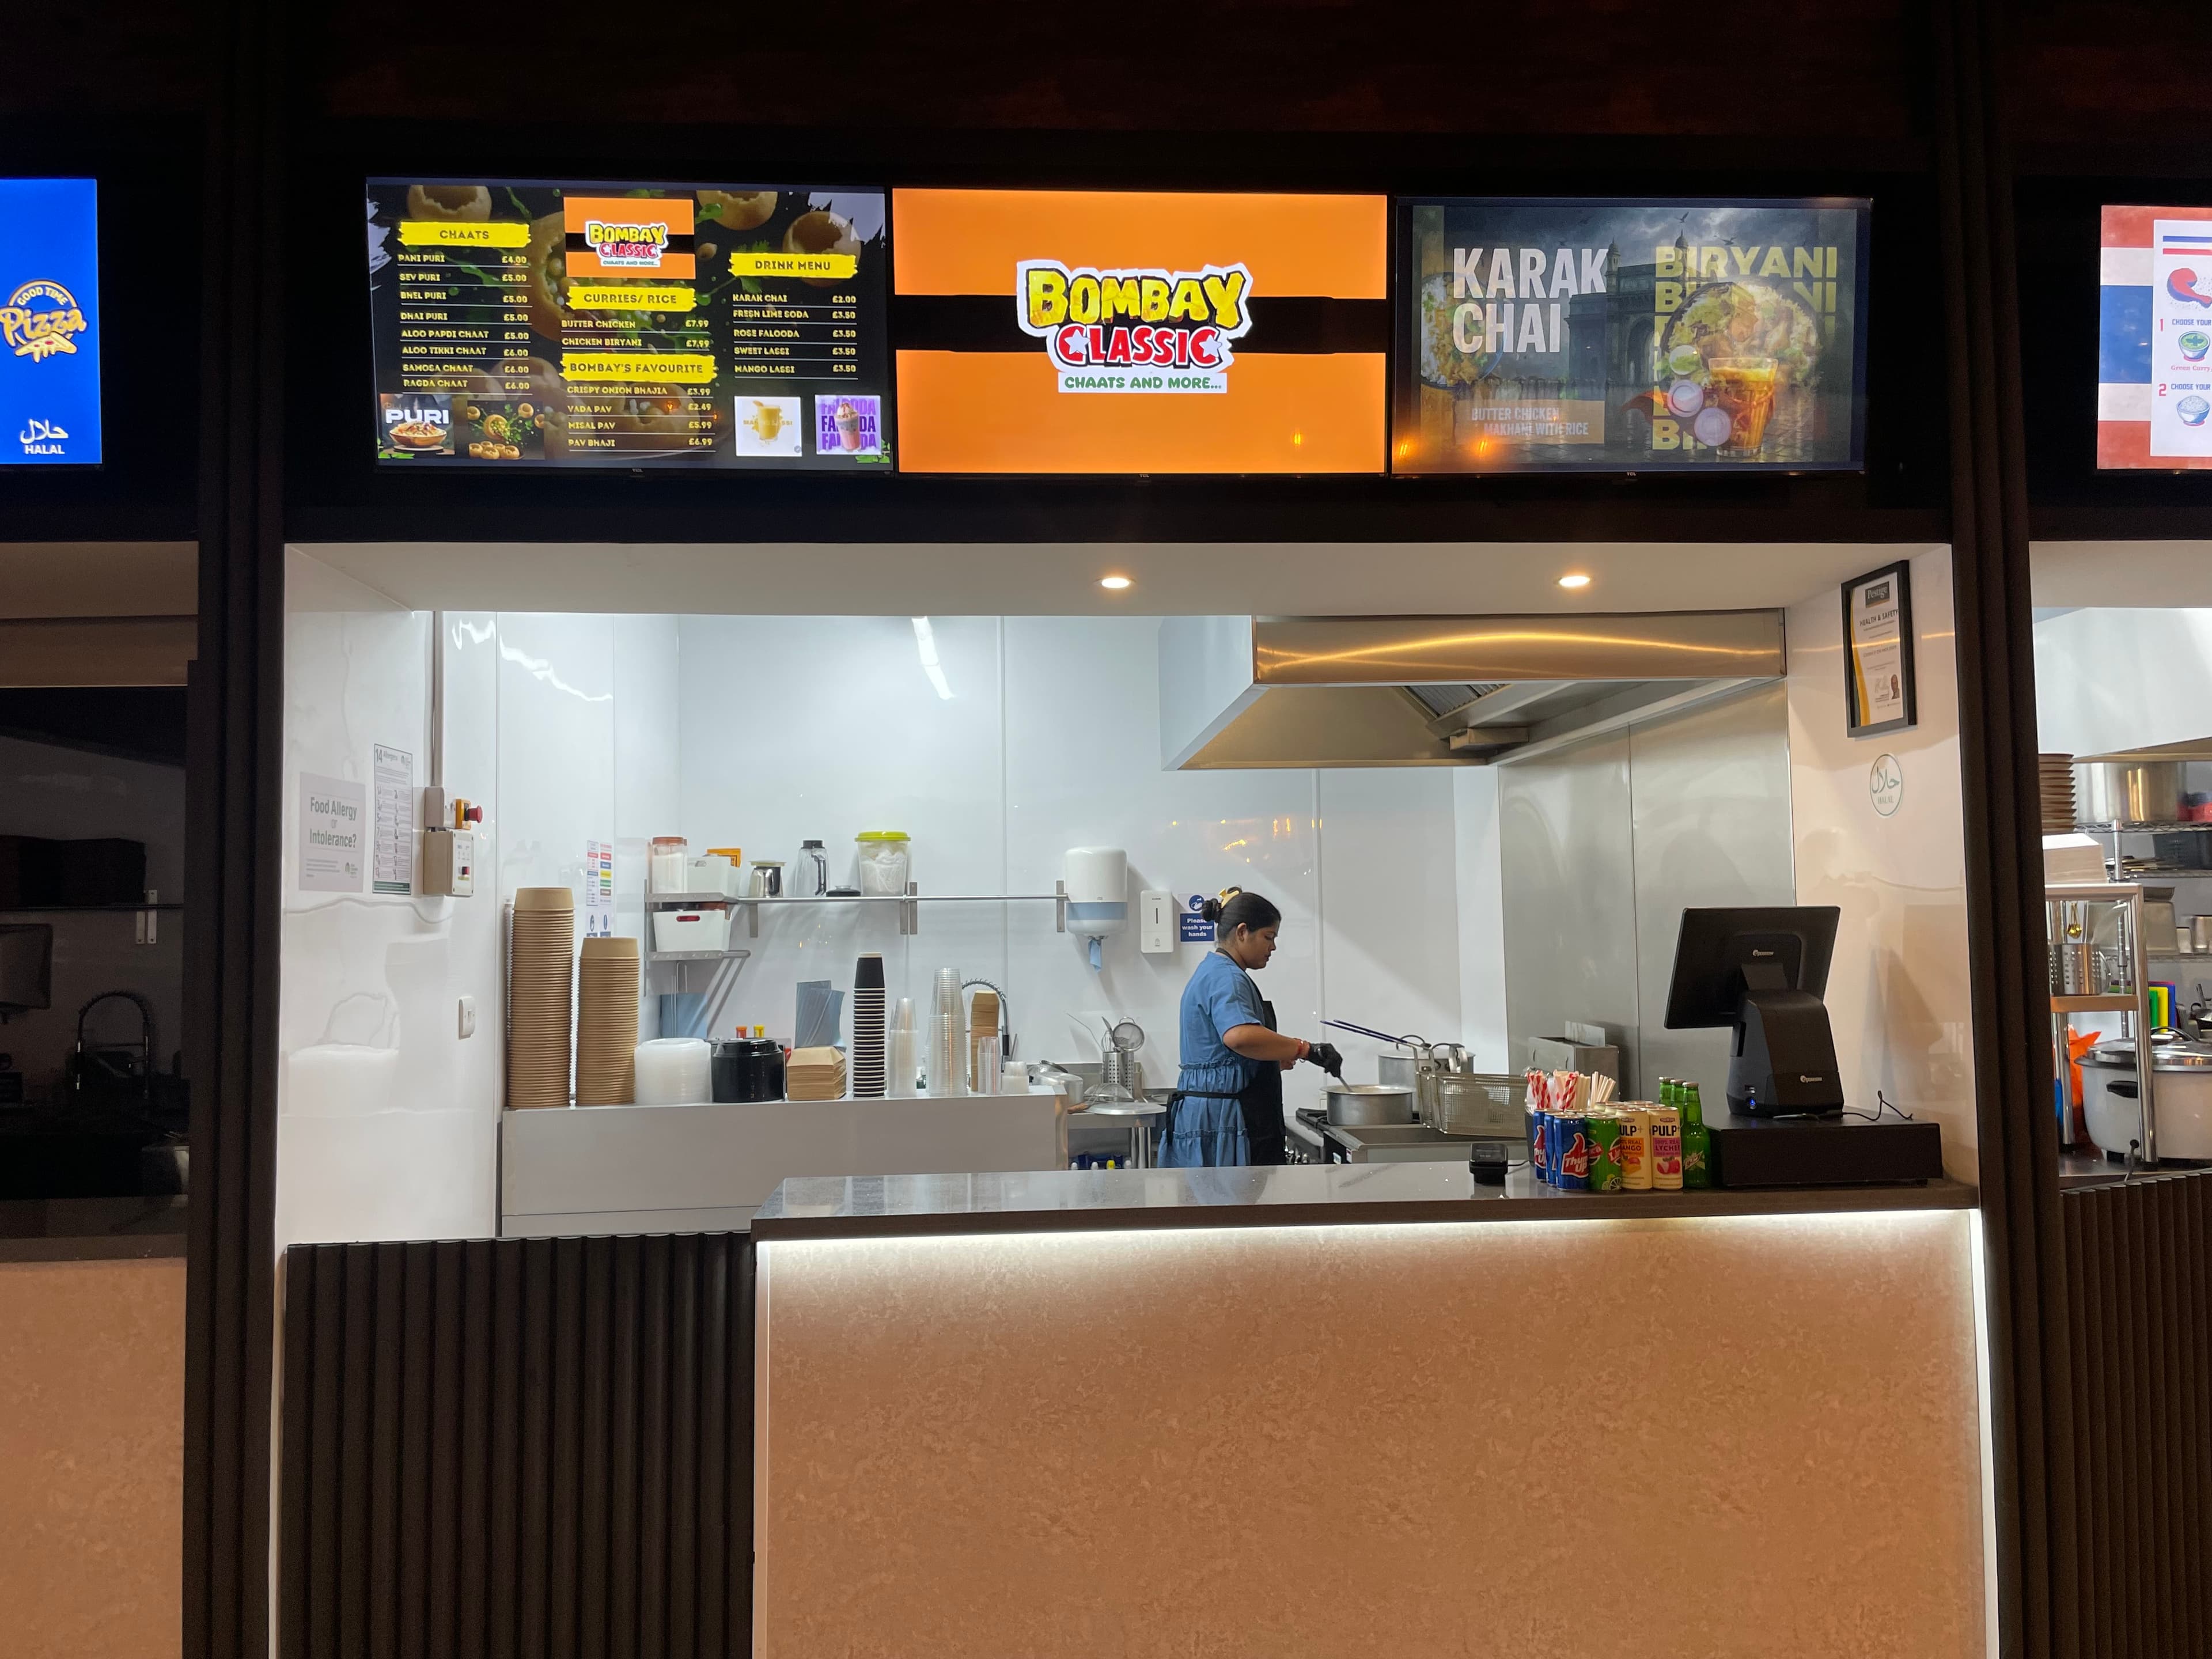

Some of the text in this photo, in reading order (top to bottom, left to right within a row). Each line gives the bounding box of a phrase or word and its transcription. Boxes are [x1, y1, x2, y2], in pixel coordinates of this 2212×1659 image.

[440, 230, 489, 239] CHAATS
[588, 224, 665, 245] BOMBAY
[599, 243, 658, 259] CLASSIC
[755, 261, 831, 270] DRINK MENU
[1656, 247, 1838, 278] BIRYANI
[399, 273, 416, 281] SEV
[1453, 248, 1609, 298] KARAK
[17, 287, 69, 306] GOOD TIME
[584, 294, 676, 304] CURRIES/ RICE
[732, 294, 763, 302] KARAK
[764, 294, 787, 302] CHAI
[1026, 267, 1246, 330] BOMBAY
[400, 312, 424, 320] DHAI
[733, 310, 856, 319] FRESH LIME SODA £3.50
[0, 307, 86, 347] Pizza
[595, 320, 636, 328] CHICKEN
[685, 320, 709, 328] £7.99
[1453, 304, 1560, 354] CHAI
[429, 330, 457, 338] PAPDI
[459, 331, 489, 339] CHAAT
[733, 329, 857, 338] ROSE FALOODA £3.50
[562, 338, 710, 347] CHICKEN BIRYANI £7.99
[1055, 324, 1223, 369] CLASSIC
[429, 347, 454, 355] TIKKI
[764, 347, 790, 355] LASSI
[832, 347, 856, 355] £3.50
[403, 364, 441, 372] SAMOSA
[442, 365, 474, 373] CHAAT
[570, 363, 703, 374] BOMBAY'S FAVOURITE
[734, 365, 857, 374] MANGO LASSI £3.50
[437, 380, 468, 388] CHAAT
[1065, 377, 1222, 389] CHAATS AND MORE...
[601, 387, 632, 395] ONION
[634, 387, 668, 395] BHAJIA
[2159, 383, 2166, 396] 2
[385, 410, 449, 424] PURI
[1472, 407, 1560, 421] BUTTER CHICKEN
[568, 422, 596, 430] MISAL
[688, 421, 712, 429] £5.99
[821, 415, 876, 432] FADA
[1484, 422, 1589, 435] MAKHANI WITH RICE
[588, 439, 615, 447] BHAJI
[688, 438, 713, 446] £6.99
[821, 433, 877, 450] FADA
[25, 445, 65, 454] HALAL
[1859, 615, 1877, 626] HEALTH
[376, 748, 382, 763] 14
[310, 797, 357, 821] Food Allergy
[309, 828, 357, 849] Intolerance?
